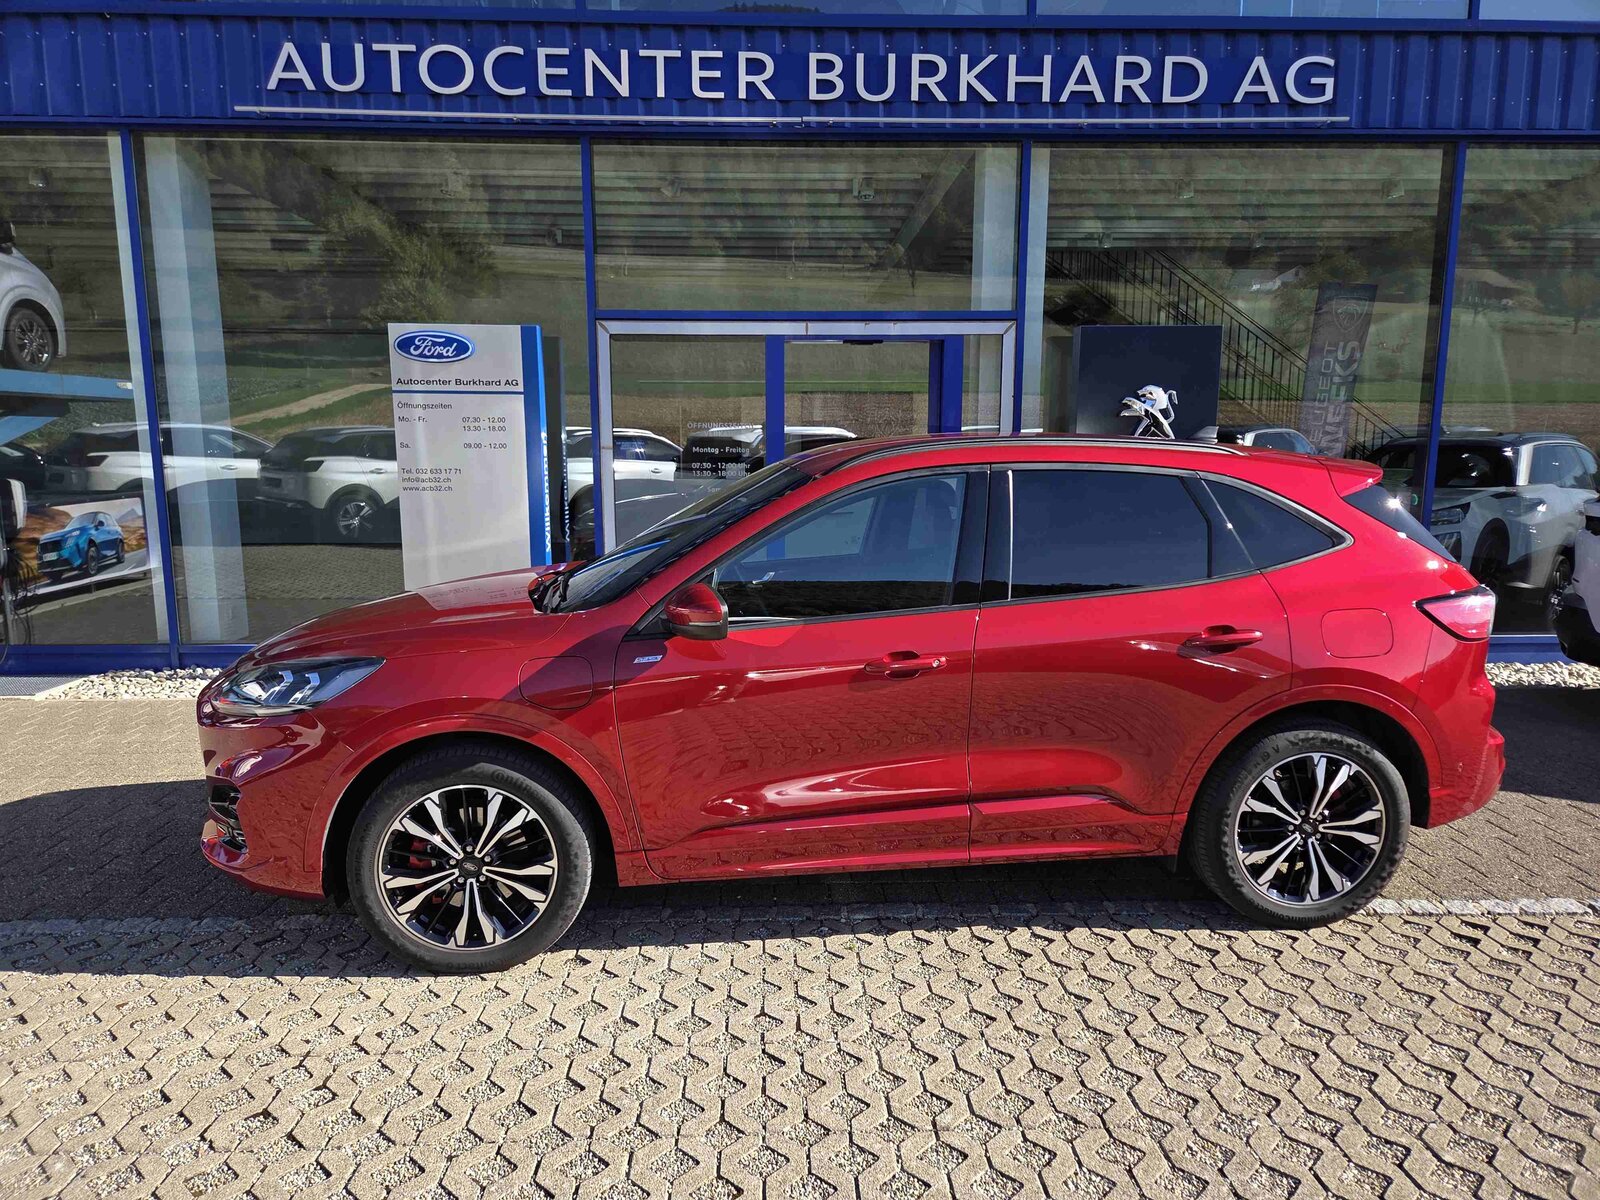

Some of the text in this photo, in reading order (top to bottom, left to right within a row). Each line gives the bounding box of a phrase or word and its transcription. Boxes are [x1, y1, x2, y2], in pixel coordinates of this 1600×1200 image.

[266, 42, 1335, 104] AUTOCENTER BURKHARD AG
[395, 377, 519, 387] Autocenter Burkhard AG
[1310, 340, 1338, 443] EUGEOT
[397, 400, 453, 411] Öffnungszeiten
[399, 441, 411, 449] Sa.
[692, 446, 719, 454] Montag
[725, 446, 750, 454] Freitag
[401, 467, 462, 475] Tel. 032 633 17 71
[401, 476, 452, 484] info@acb32.ch
